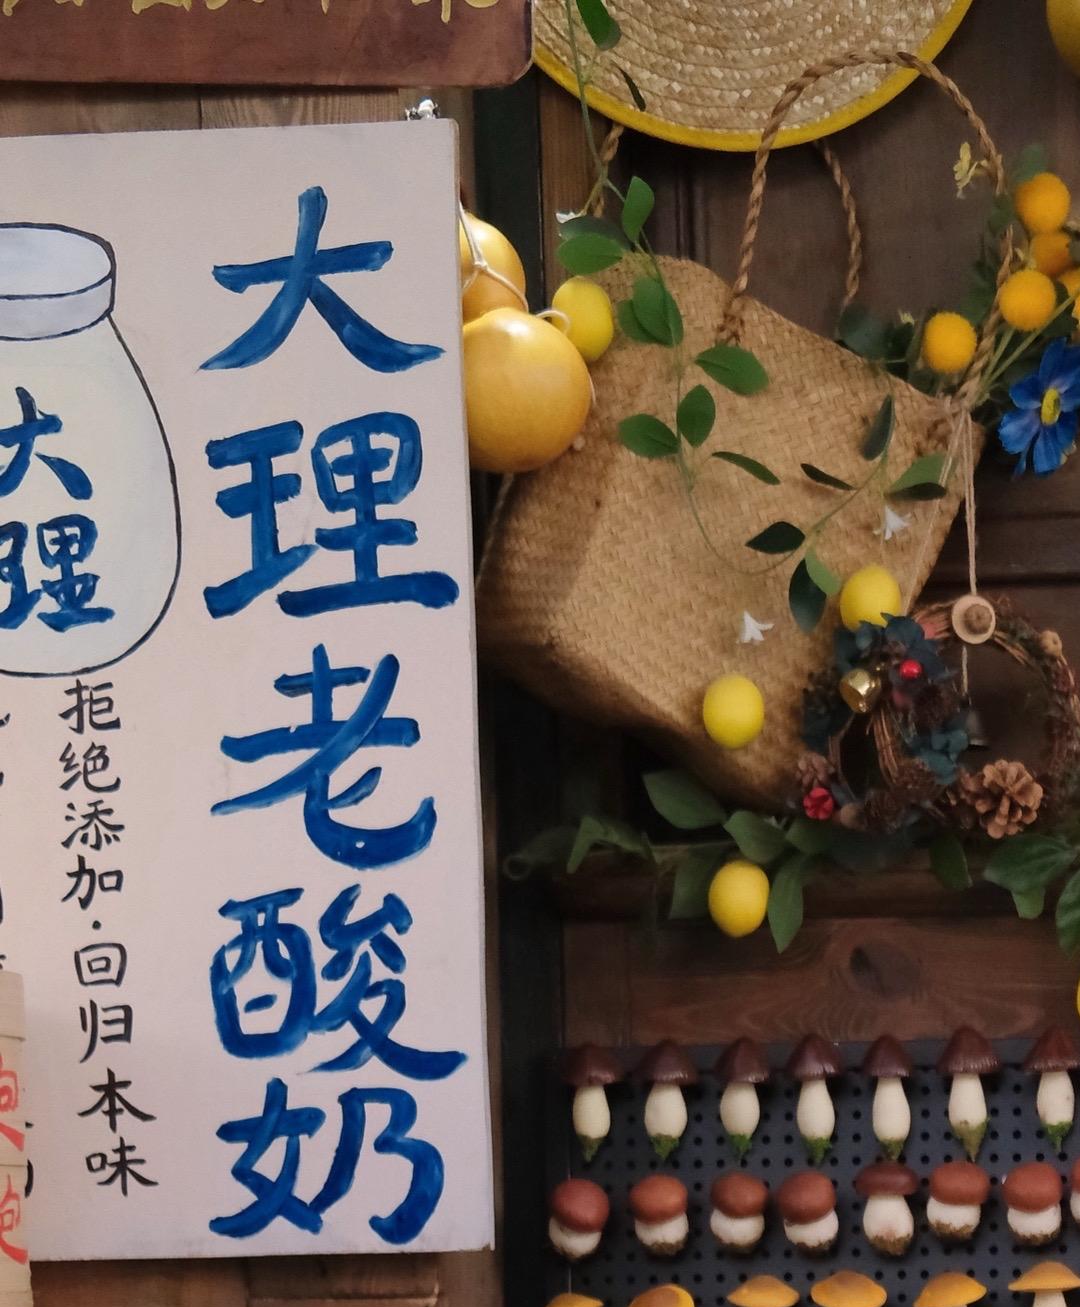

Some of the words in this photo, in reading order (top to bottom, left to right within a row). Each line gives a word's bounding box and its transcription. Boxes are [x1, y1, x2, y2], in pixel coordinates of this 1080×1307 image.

[198, 185, 466, 1245] 大理老酸奶
